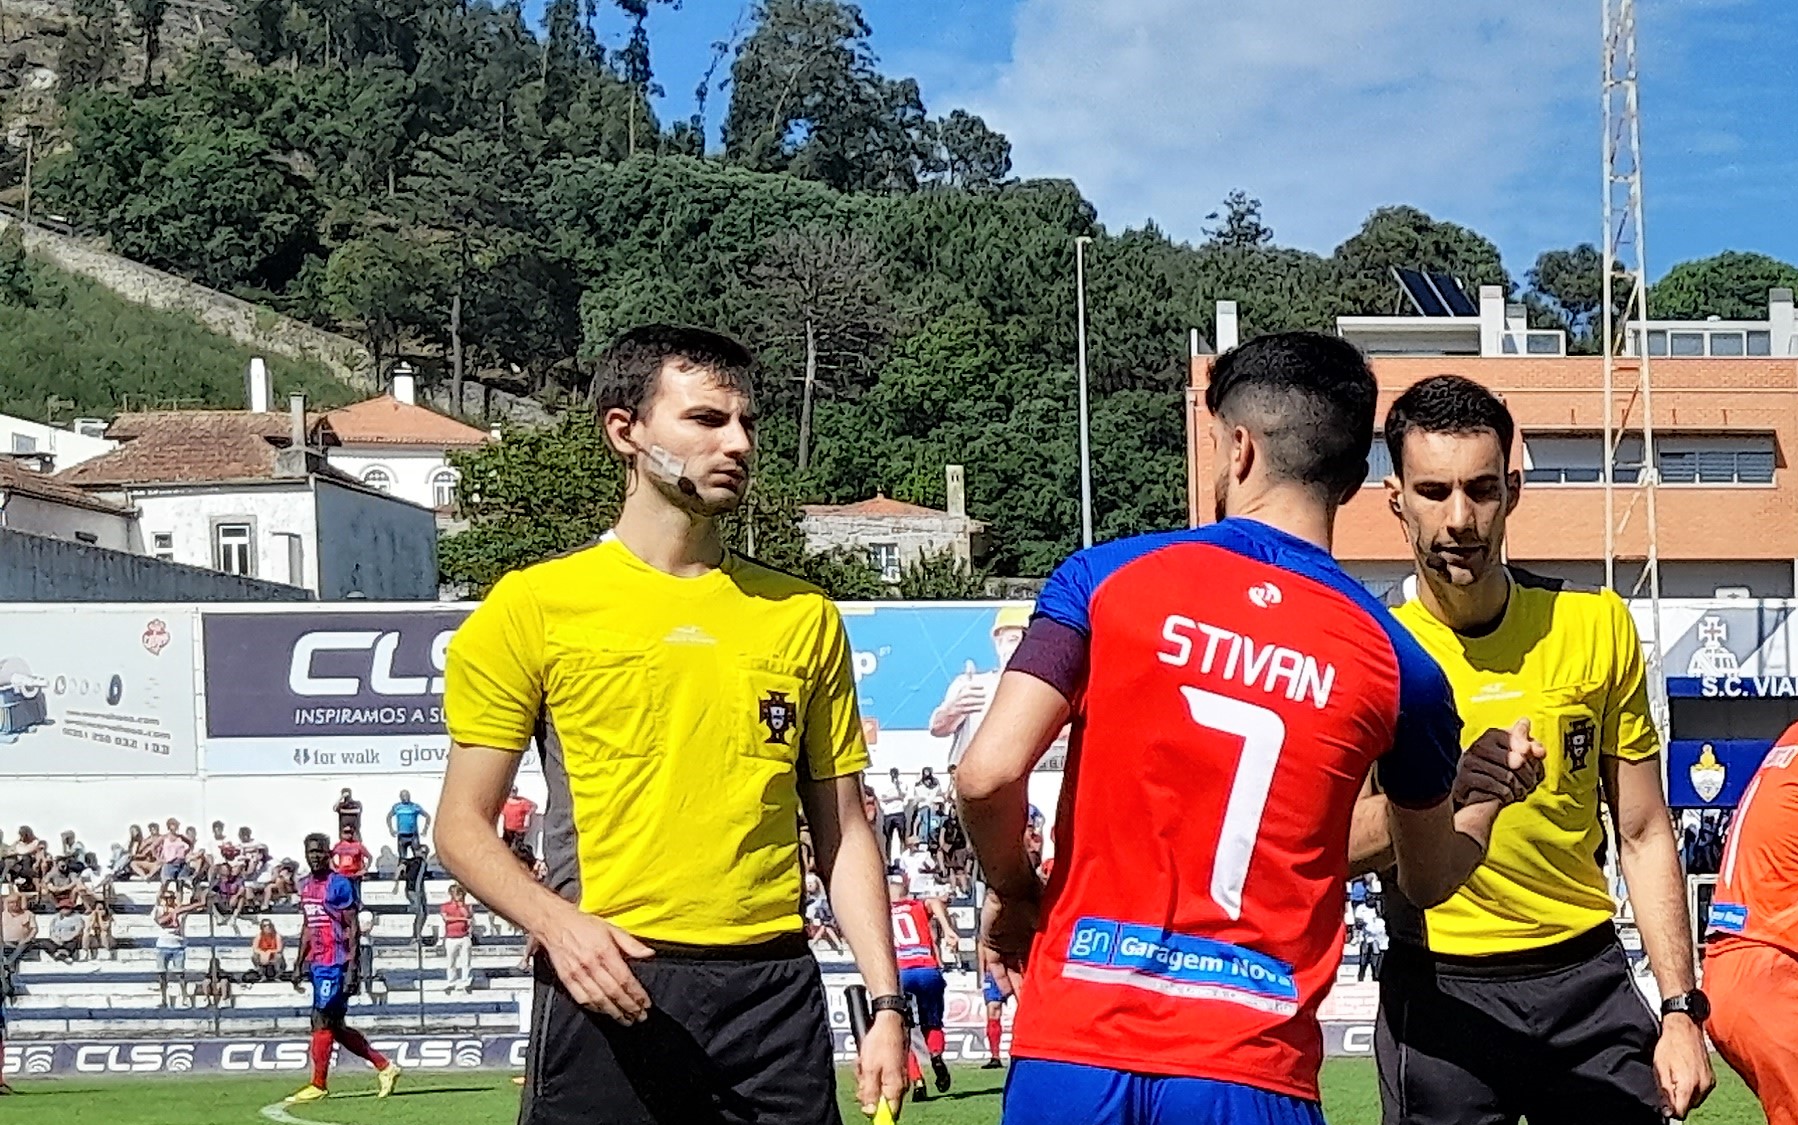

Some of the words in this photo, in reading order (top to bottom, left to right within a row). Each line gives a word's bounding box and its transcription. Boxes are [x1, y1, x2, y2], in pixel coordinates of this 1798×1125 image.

[1156, 614, 1336, 710] STIVAN
[1702, 676, 1749, 697] S.C.
[295, 708, 405, 725] INSPIRAMOS
[411, 709, 426, 723] A
[313, 750, 336, 765] for
[341, 749, 380, 765] walk
[400, 747, 448, 766] giov
[1179, 684, 1286, 922] 7
[1072, 927, 1110, 957] gn
[1121, 936, 1224, 975] Garagem
